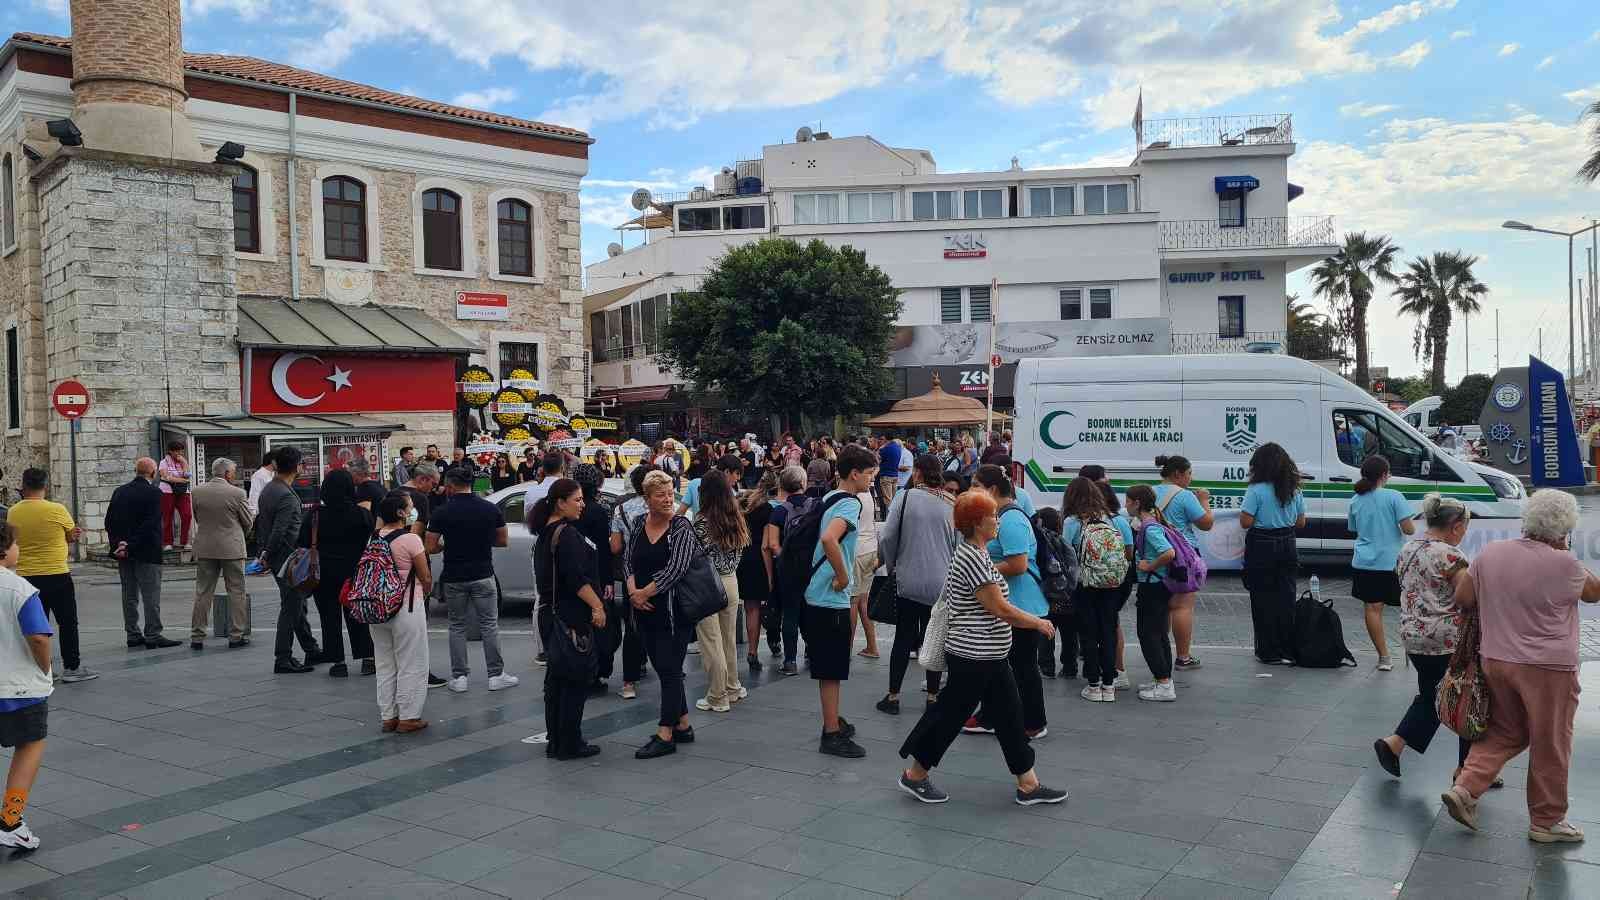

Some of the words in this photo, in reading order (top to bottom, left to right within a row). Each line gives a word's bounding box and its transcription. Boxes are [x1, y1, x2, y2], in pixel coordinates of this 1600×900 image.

[1168, 271, 1216, 284] GURUP
[1220, 269, 1264, 282] HOTEL
[1076, 332, 1116, 345] ZEN'SİZ
[1118, 333, 1154, 344] OLMAZ
[1540, 381, 1558, 424] LİMANI
[1087, 418, 1122, 429] BODRUM
[1123, 416, 1171, 429] BELEDİYESİ
[1078, 431, 1117, 442] CENAZE
[1152, 431, 1183, 442] ARACI
[1544, 427, 1560, 479] BODRUM
